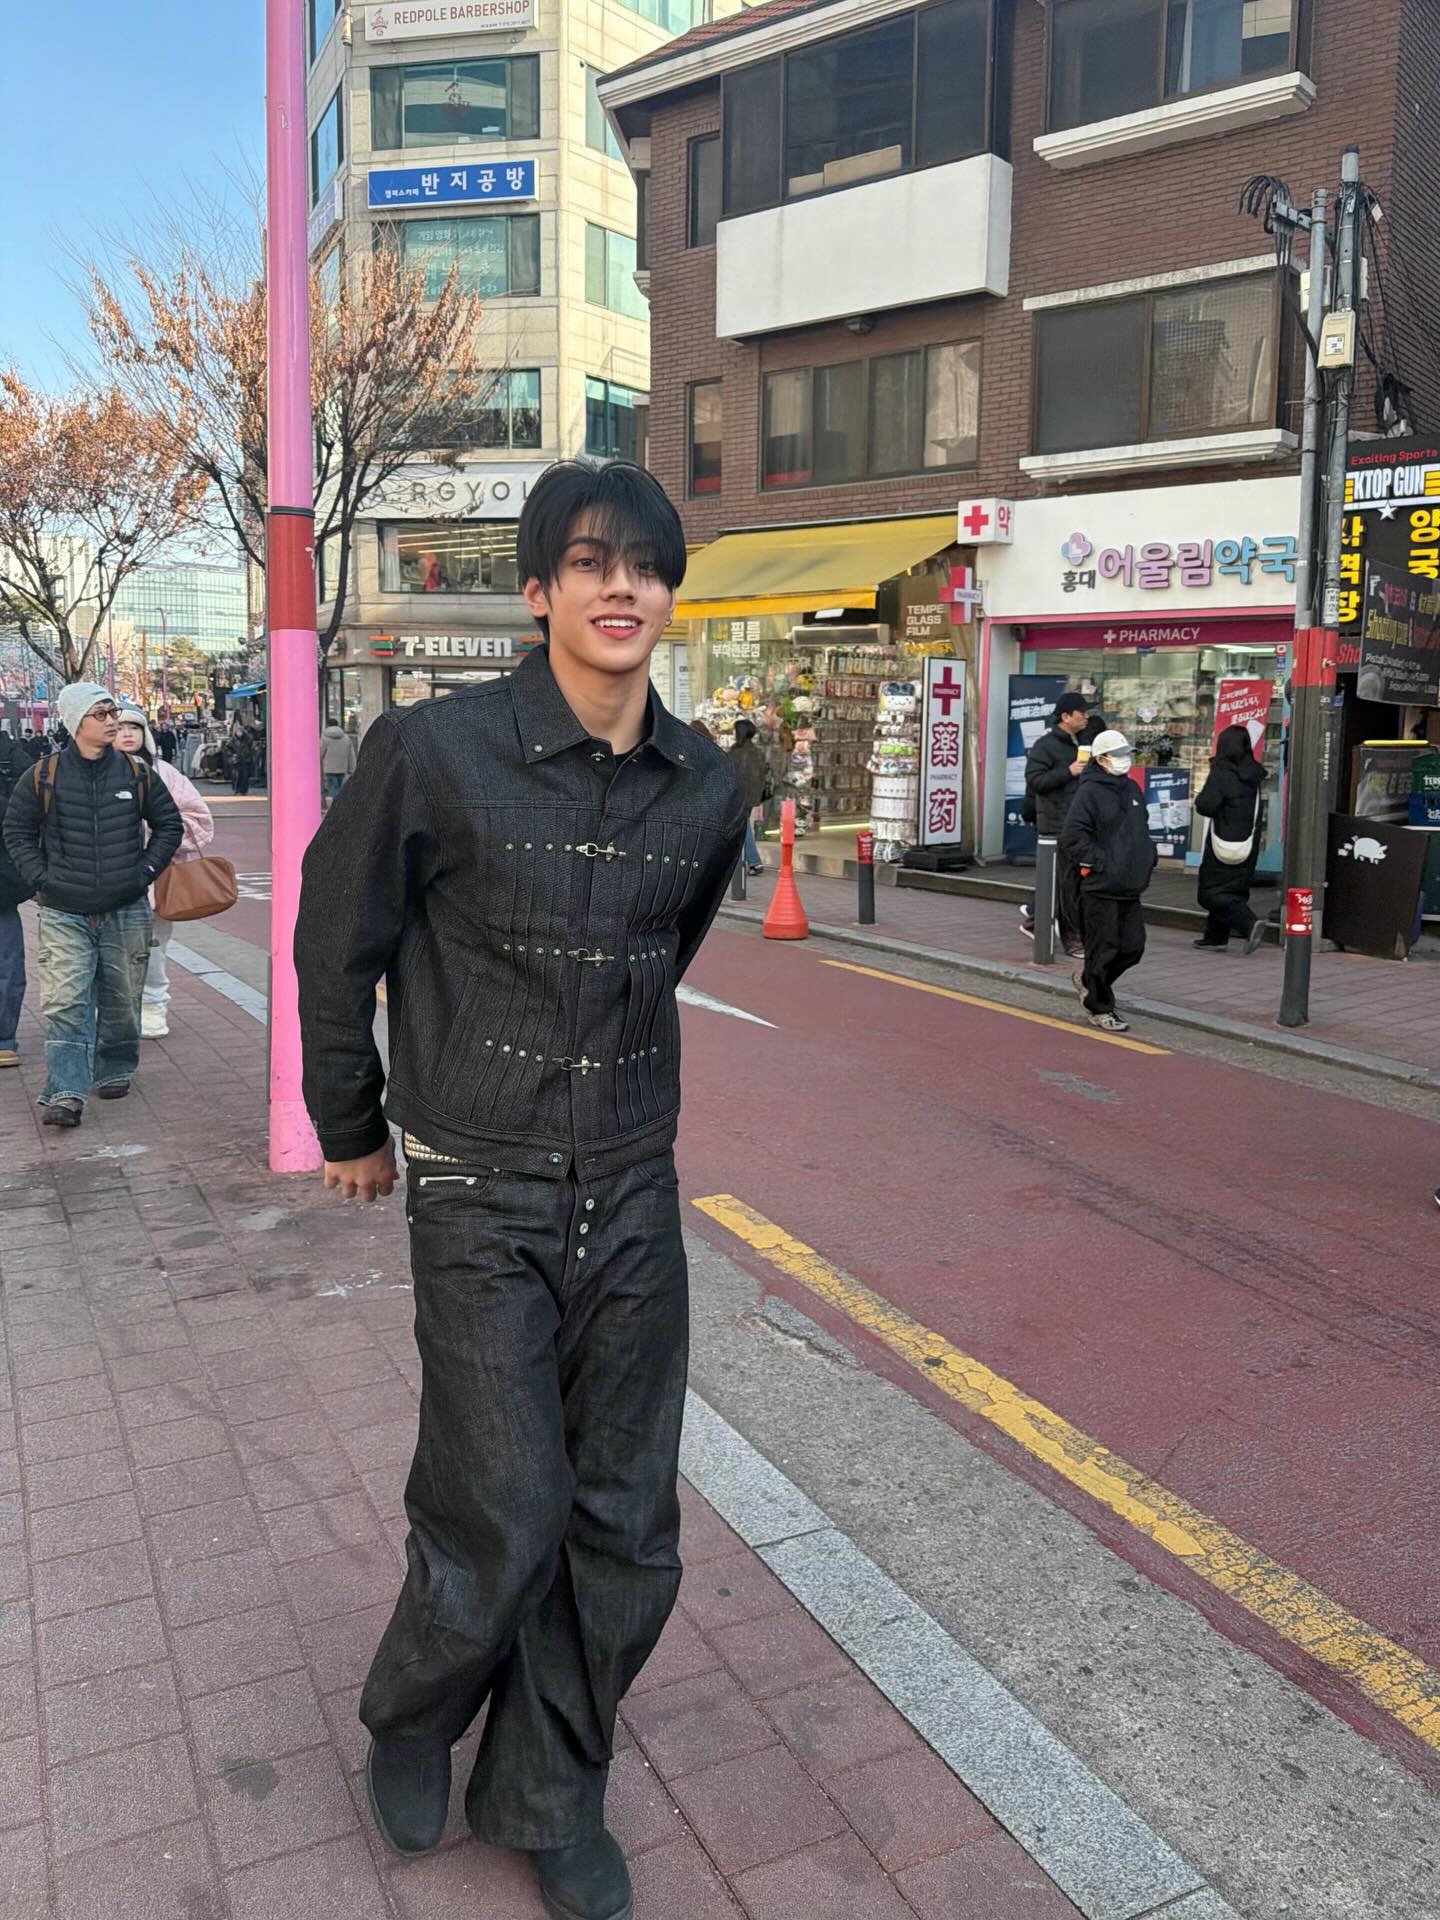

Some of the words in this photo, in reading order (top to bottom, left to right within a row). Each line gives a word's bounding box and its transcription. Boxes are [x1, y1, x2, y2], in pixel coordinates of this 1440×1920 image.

[394, 7, 447, 24] REDPOLE
[450, 0, 530, 20] BARBERSHOP
[1351, 453, 1397, 465] Exciting
[1399, 448, 1438, 462] Sports
[1354, 467, 1392, 500] KTOP
[1393, 464, 1425, 497] GUN
[998, 506, 1011, 537] 약
[1061, 569, 1097, 593] 홍대
[1098, 536, 1298, 591] 어울림약국
[906, 604, 945, 616] TEMPE
[906, 615, 942, 626] GLASS
[730, 621, 761, 642] 필름
[906, 626, 931, 637] FILM
[1119, 627, 1201, 643] PHARMACY
[929, 788, 957, 833] 药
